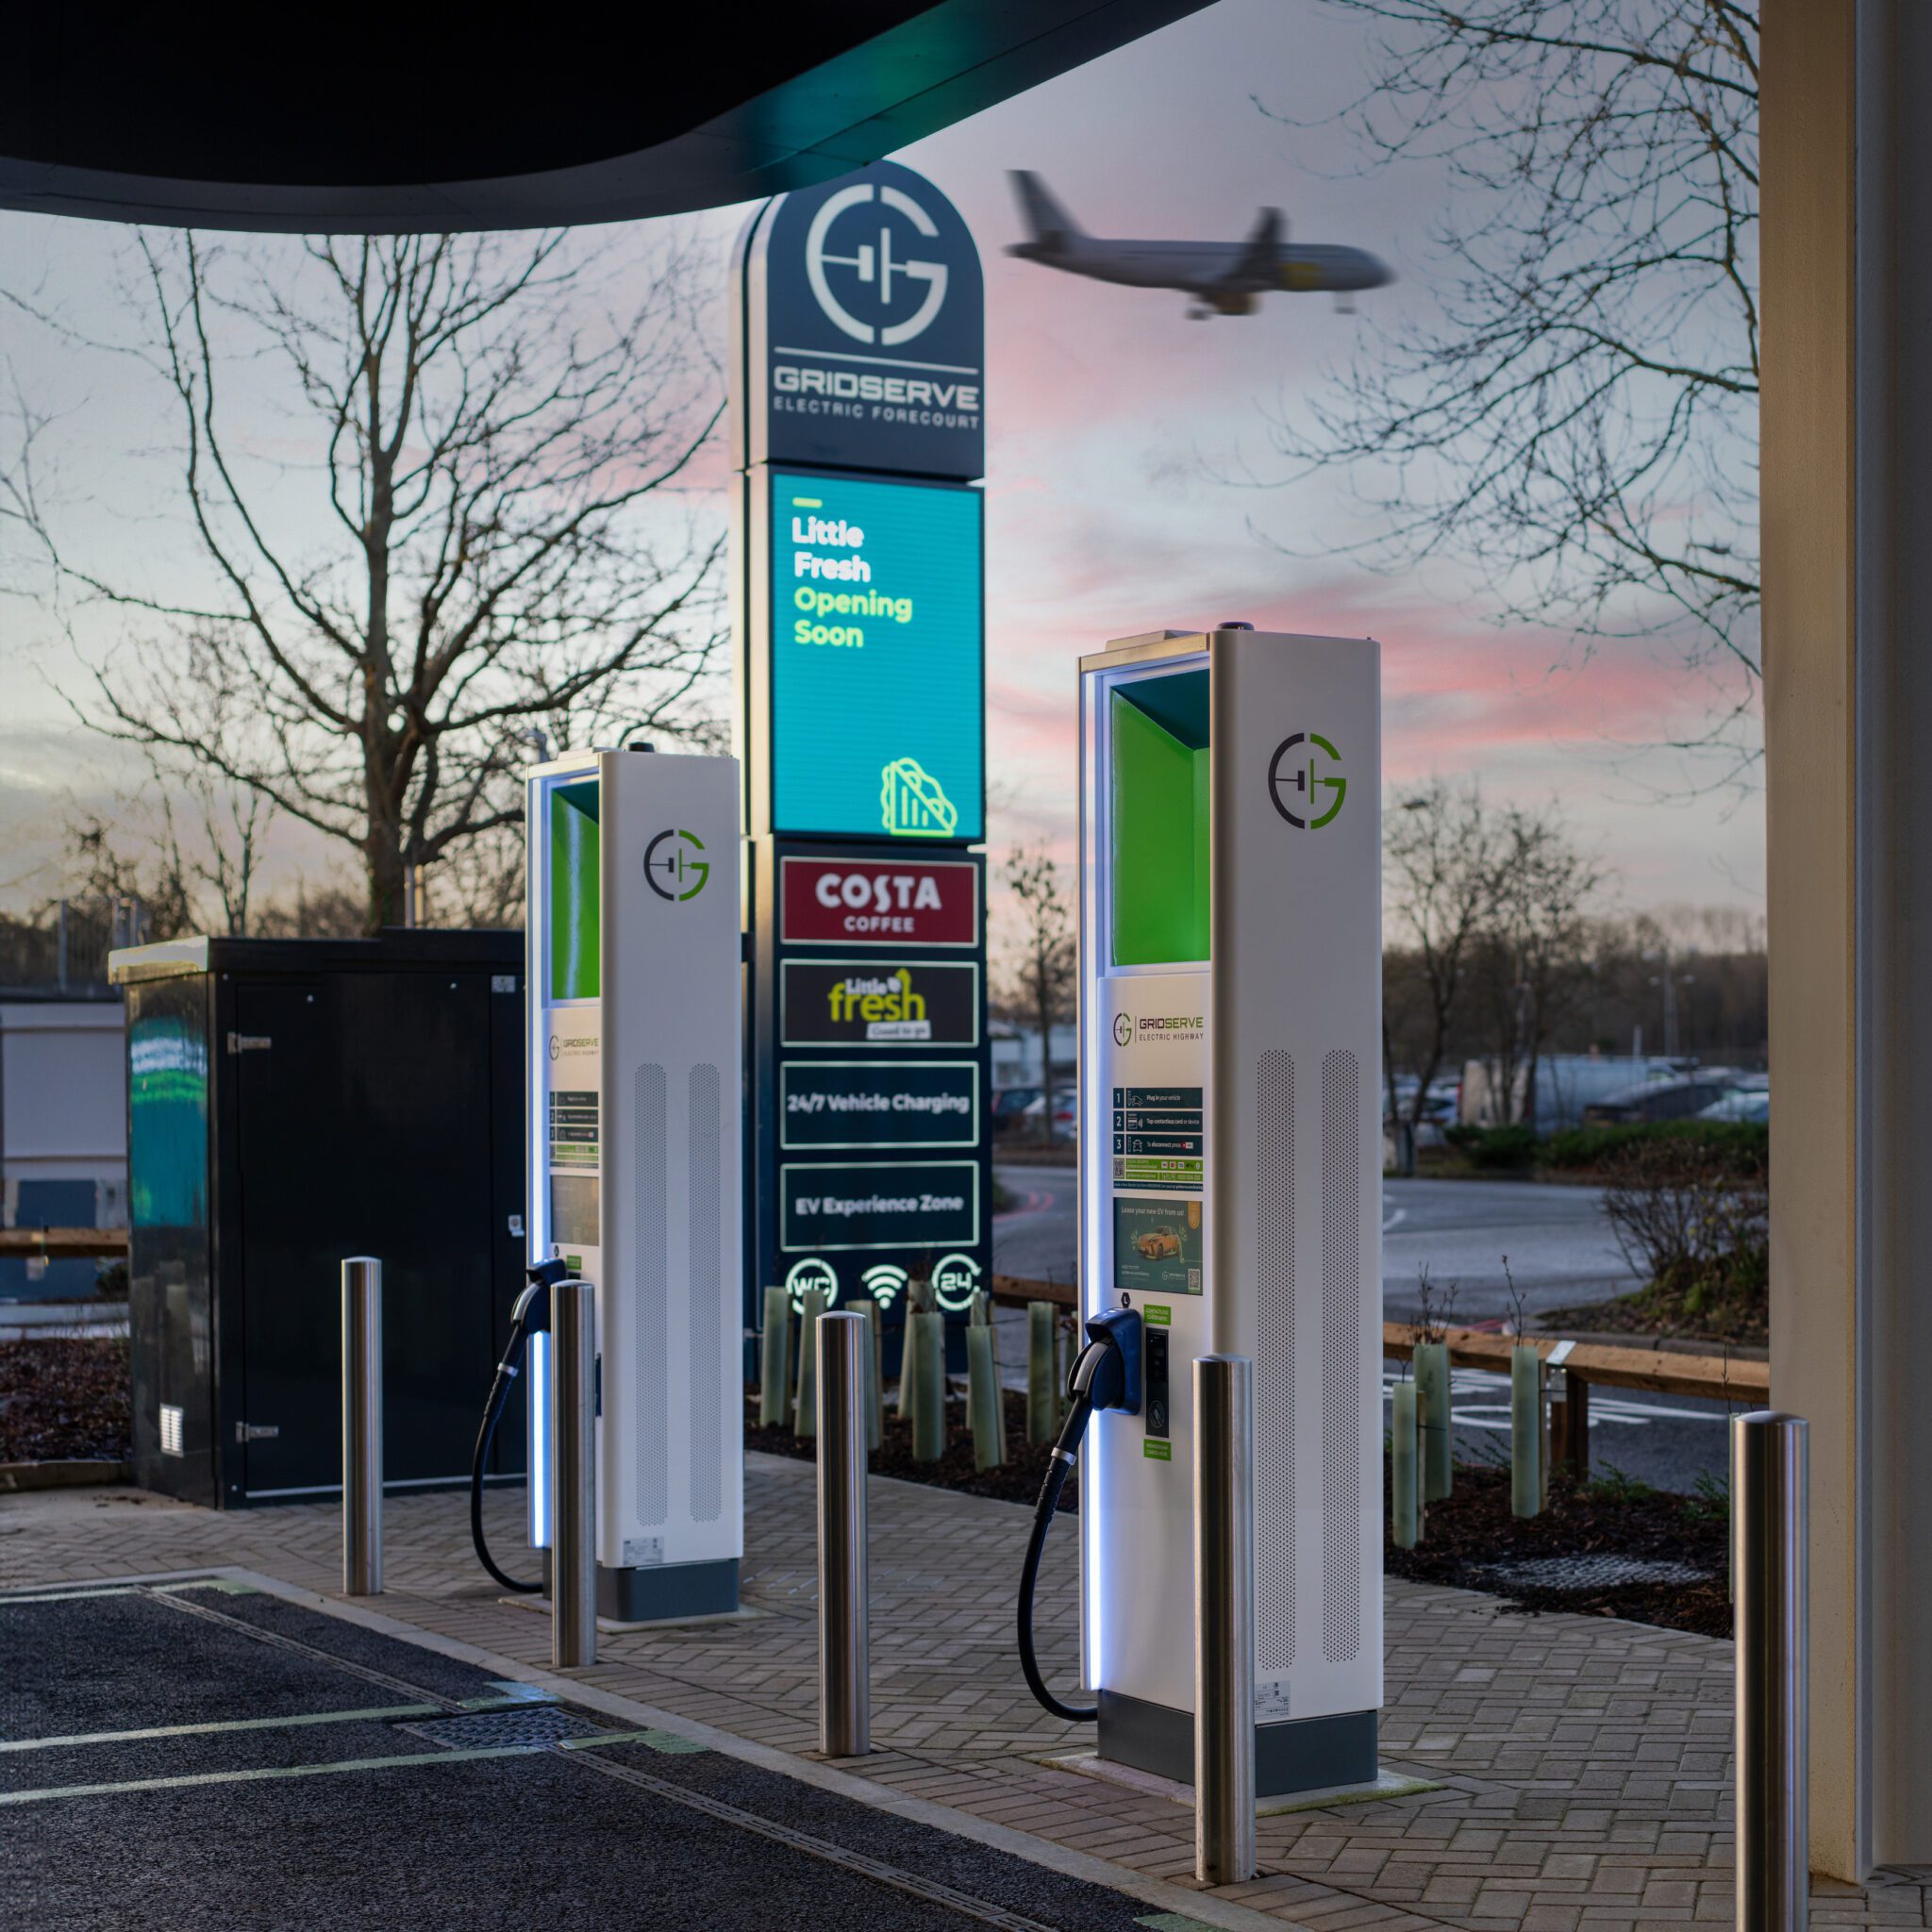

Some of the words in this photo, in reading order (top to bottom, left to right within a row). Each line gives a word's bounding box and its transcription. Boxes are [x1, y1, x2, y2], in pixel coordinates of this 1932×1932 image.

[774, 366, 979, 410] GRIDSERVE
[774, 396, 863, 418] ELECTRIC
[872, 406, 979, 429] FORECOURT
[791, 515, 864, 547] Little
[794, 551, 871, 582] Fresh
[794, 587, 913, 623] Opening
[794, 620, 864, 647] Soon
[815, 873, 941, 913] COSTA
[844, 916, 914, 932] COFFEE
[827, 968, 925, 1022] fresh
[844, 977, 888, 995] Little
[1139, 1017, 1203, 1029] GRIDSERVE
[788, 1093, 825, 1113] 24/7
[828, 1092, 890, 1111] Vehicle
[892, 1092, 970, 1114] Charging
[1116, 1116, 1121, 1126] 2
[1116, 1140, 1122, 1149] 3
[795, 1198, 820, 1215] EV
[824, 1195, 918, 1217] Experience
[920, 1194, 964, 1211] Zone
